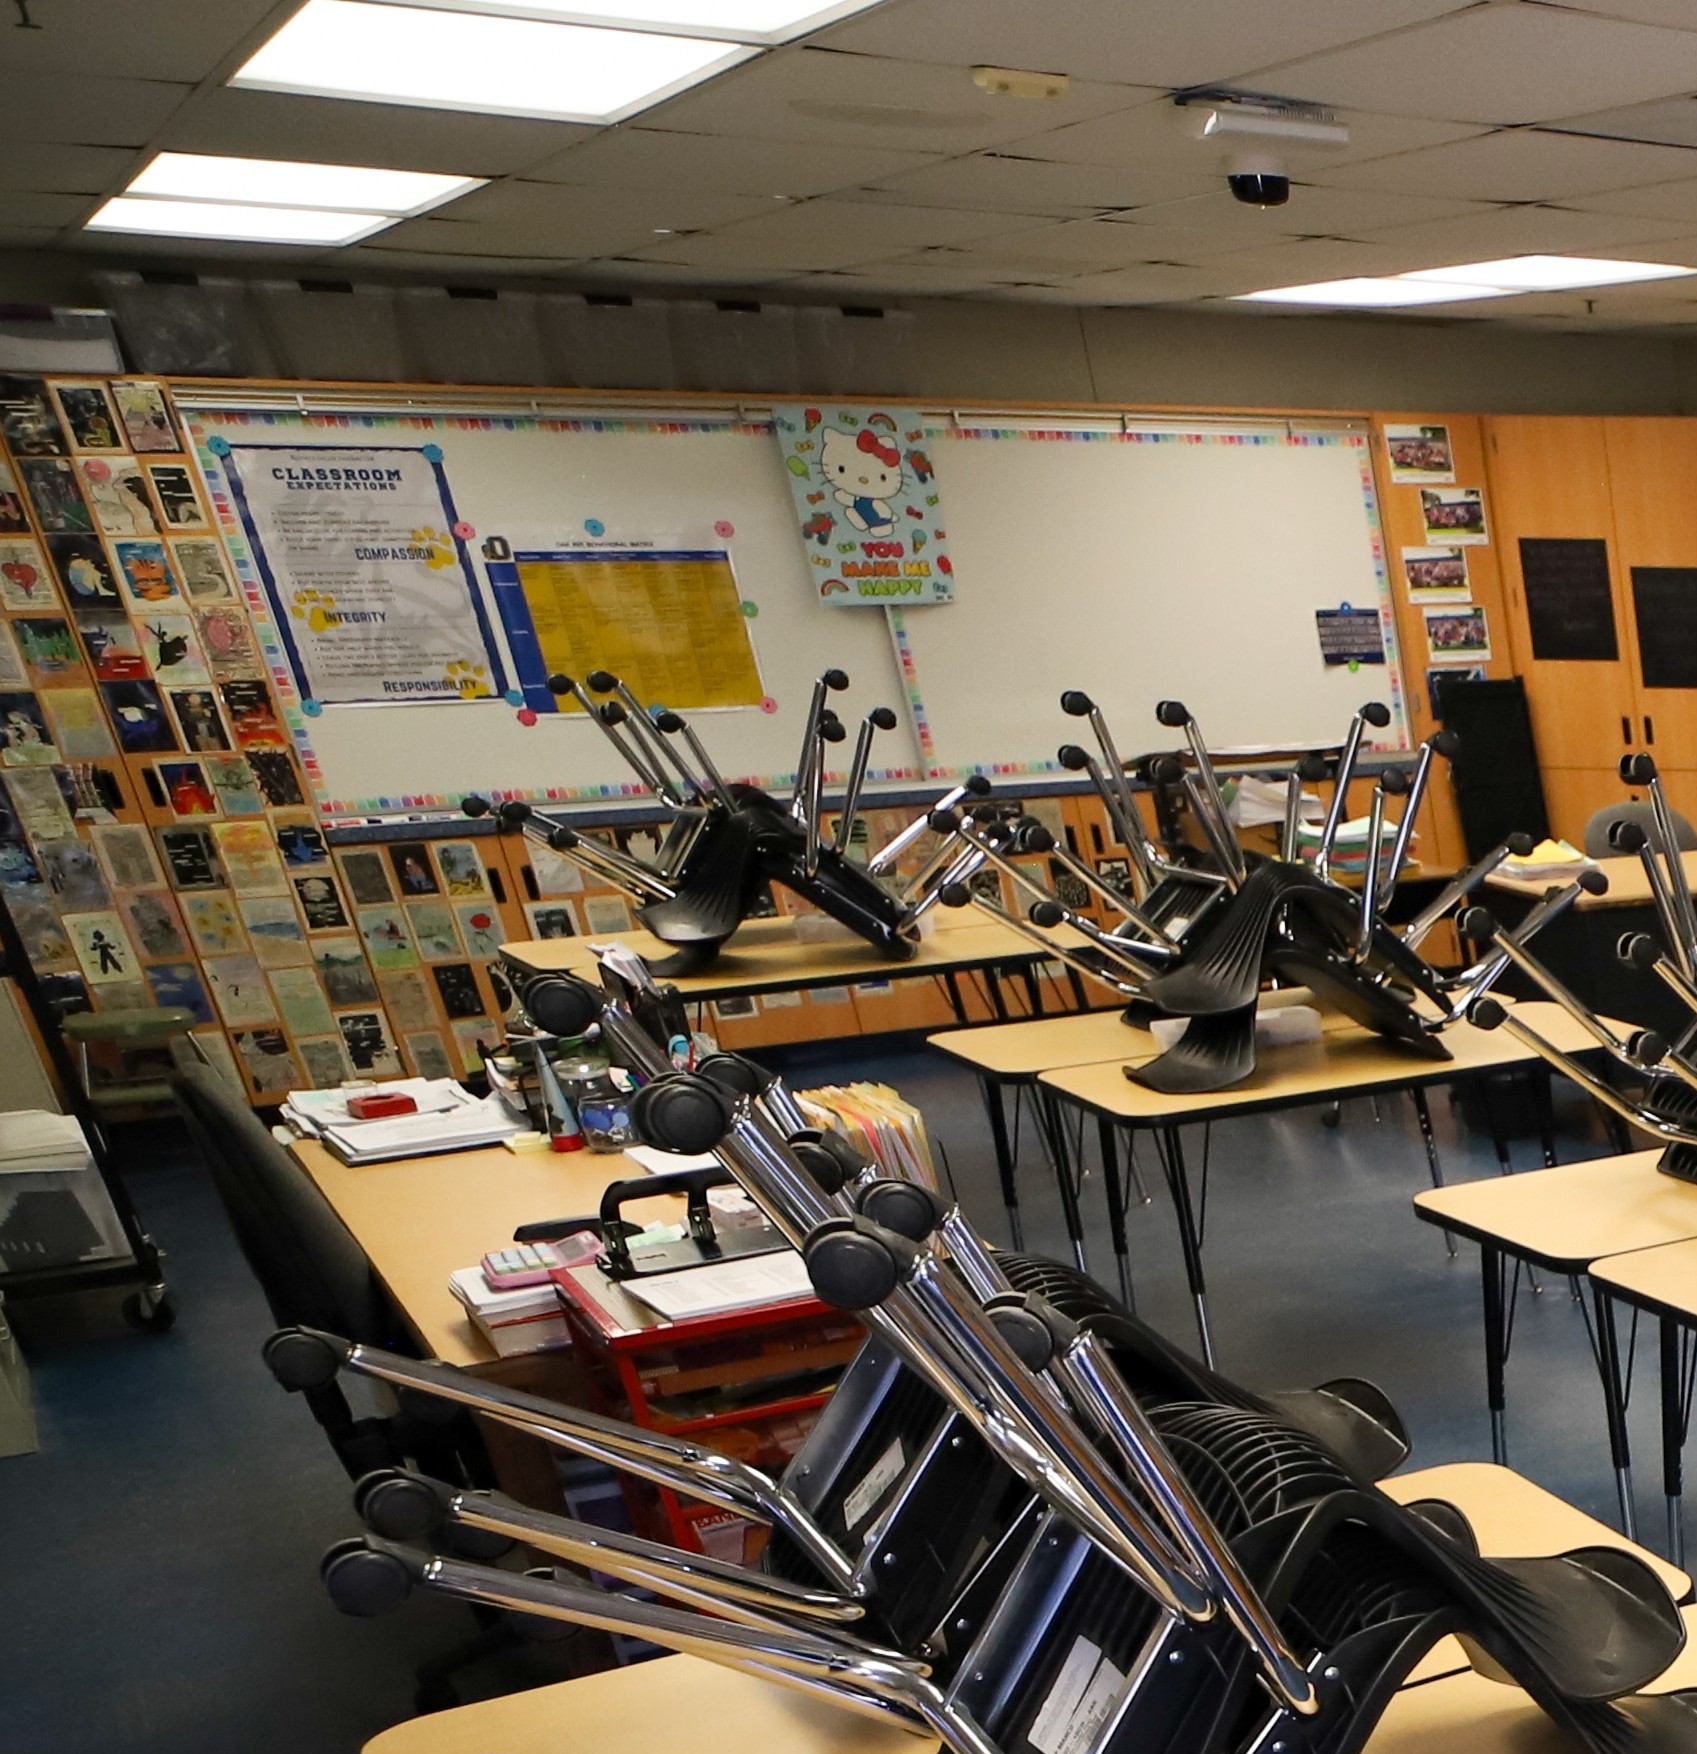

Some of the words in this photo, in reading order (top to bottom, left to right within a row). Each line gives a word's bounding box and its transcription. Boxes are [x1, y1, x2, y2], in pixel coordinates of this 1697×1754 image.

[271, 467, 403, 483] CLASSROOM
[286, 480, 399, 492] EXPECTATIONS
[354, 546, 436, 563] COMPASSION
[860, 541, 905, 560] YOU
[841, 560, 901, 578] MAKE
[904, 560, 932, 578] ME
[856, 579, 924, 597] HAPPY
[323, 610, 388, 625] INTEGRITY
[382, 680, 479, 695] RESPONSIBILITY
